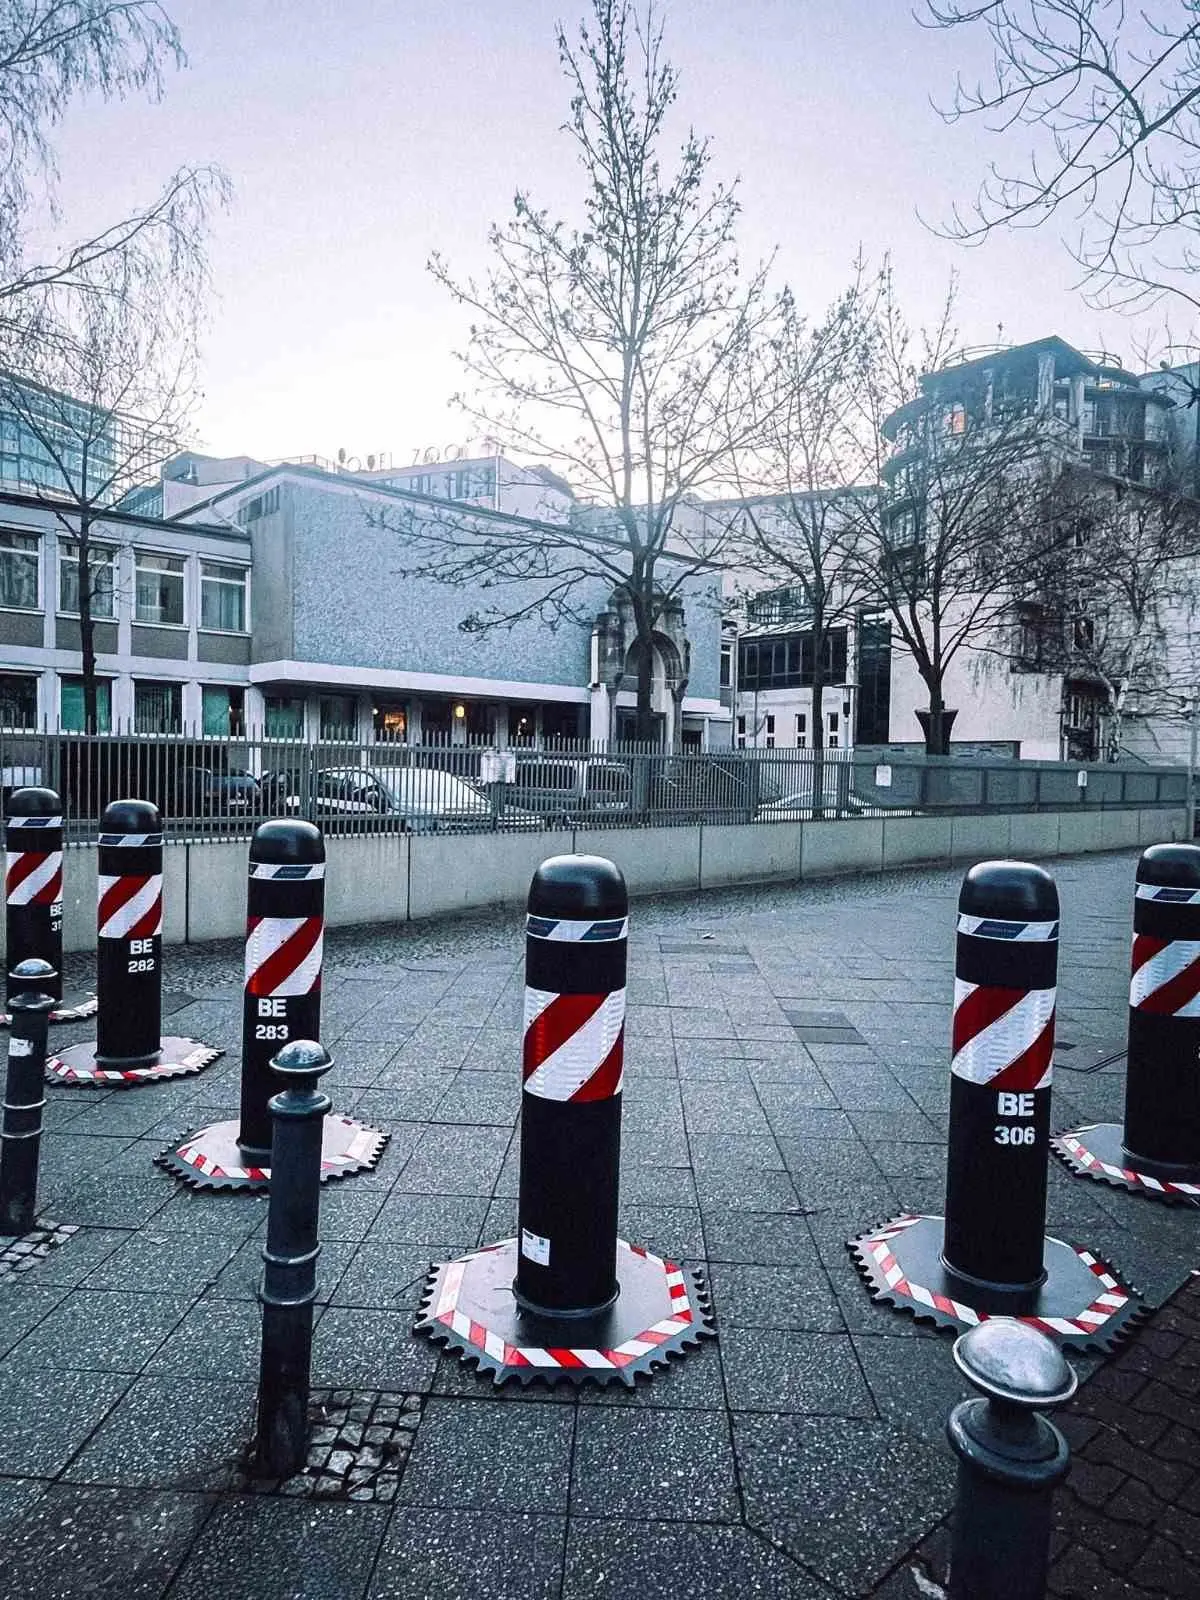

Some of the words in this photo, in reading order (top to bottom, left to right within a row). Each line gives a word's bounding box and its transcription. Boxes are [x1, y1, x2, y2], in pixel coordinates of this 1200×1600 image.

[50, 903, 63, 917] BE
[130, 938, 153, 955] BE
[127, 958, 155, 973] 282
[258, 998, 287, 1018] BE
[255, 1023, 289, 1042] 283
[997, 1092, 1035, 1117] BE
[994, 1125, 1036, 1146] 306
